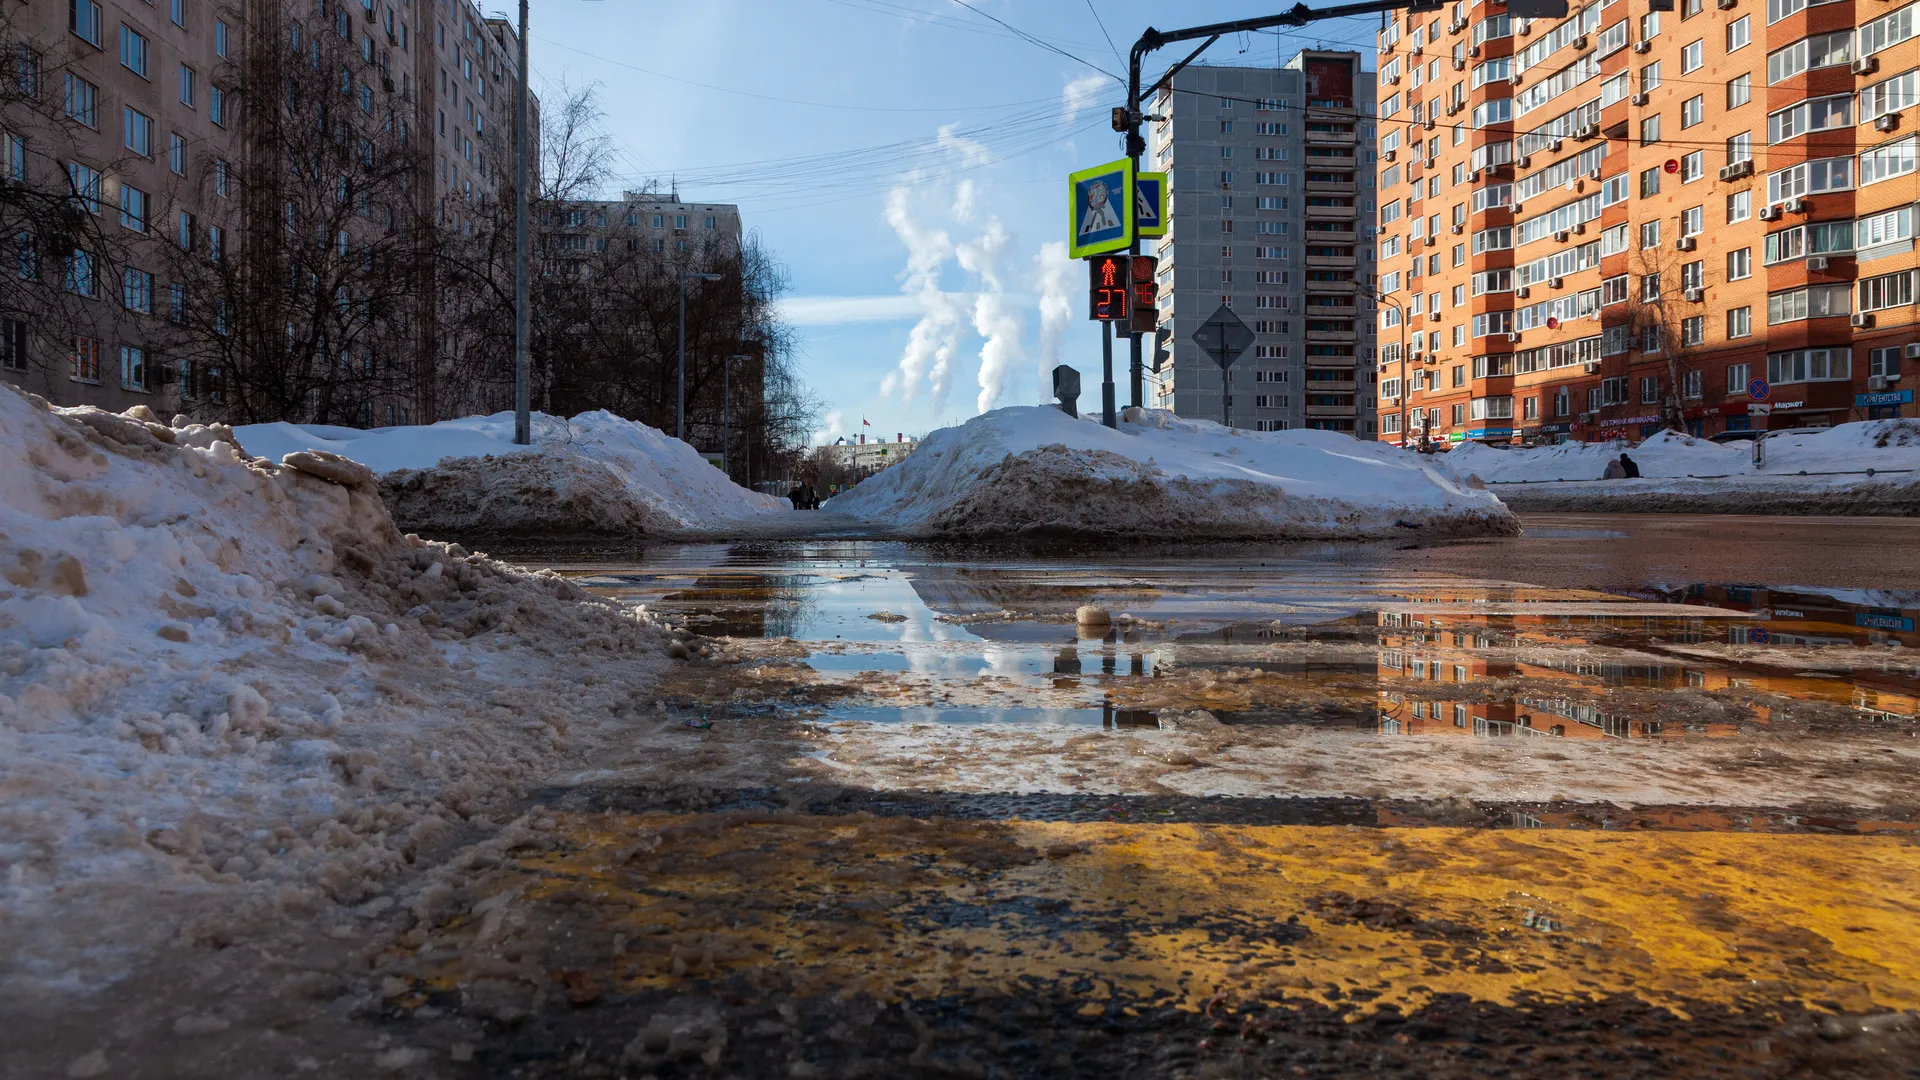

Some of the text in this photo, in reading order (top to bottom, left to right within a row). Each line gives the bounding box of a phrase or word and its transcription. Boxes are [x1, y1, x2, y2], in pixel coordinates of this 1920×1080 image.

[1097, 289, 1125, 318] 27
[1134, 283, 1153, 304] 46
[1773, 401, 1804, 409] Маркет
